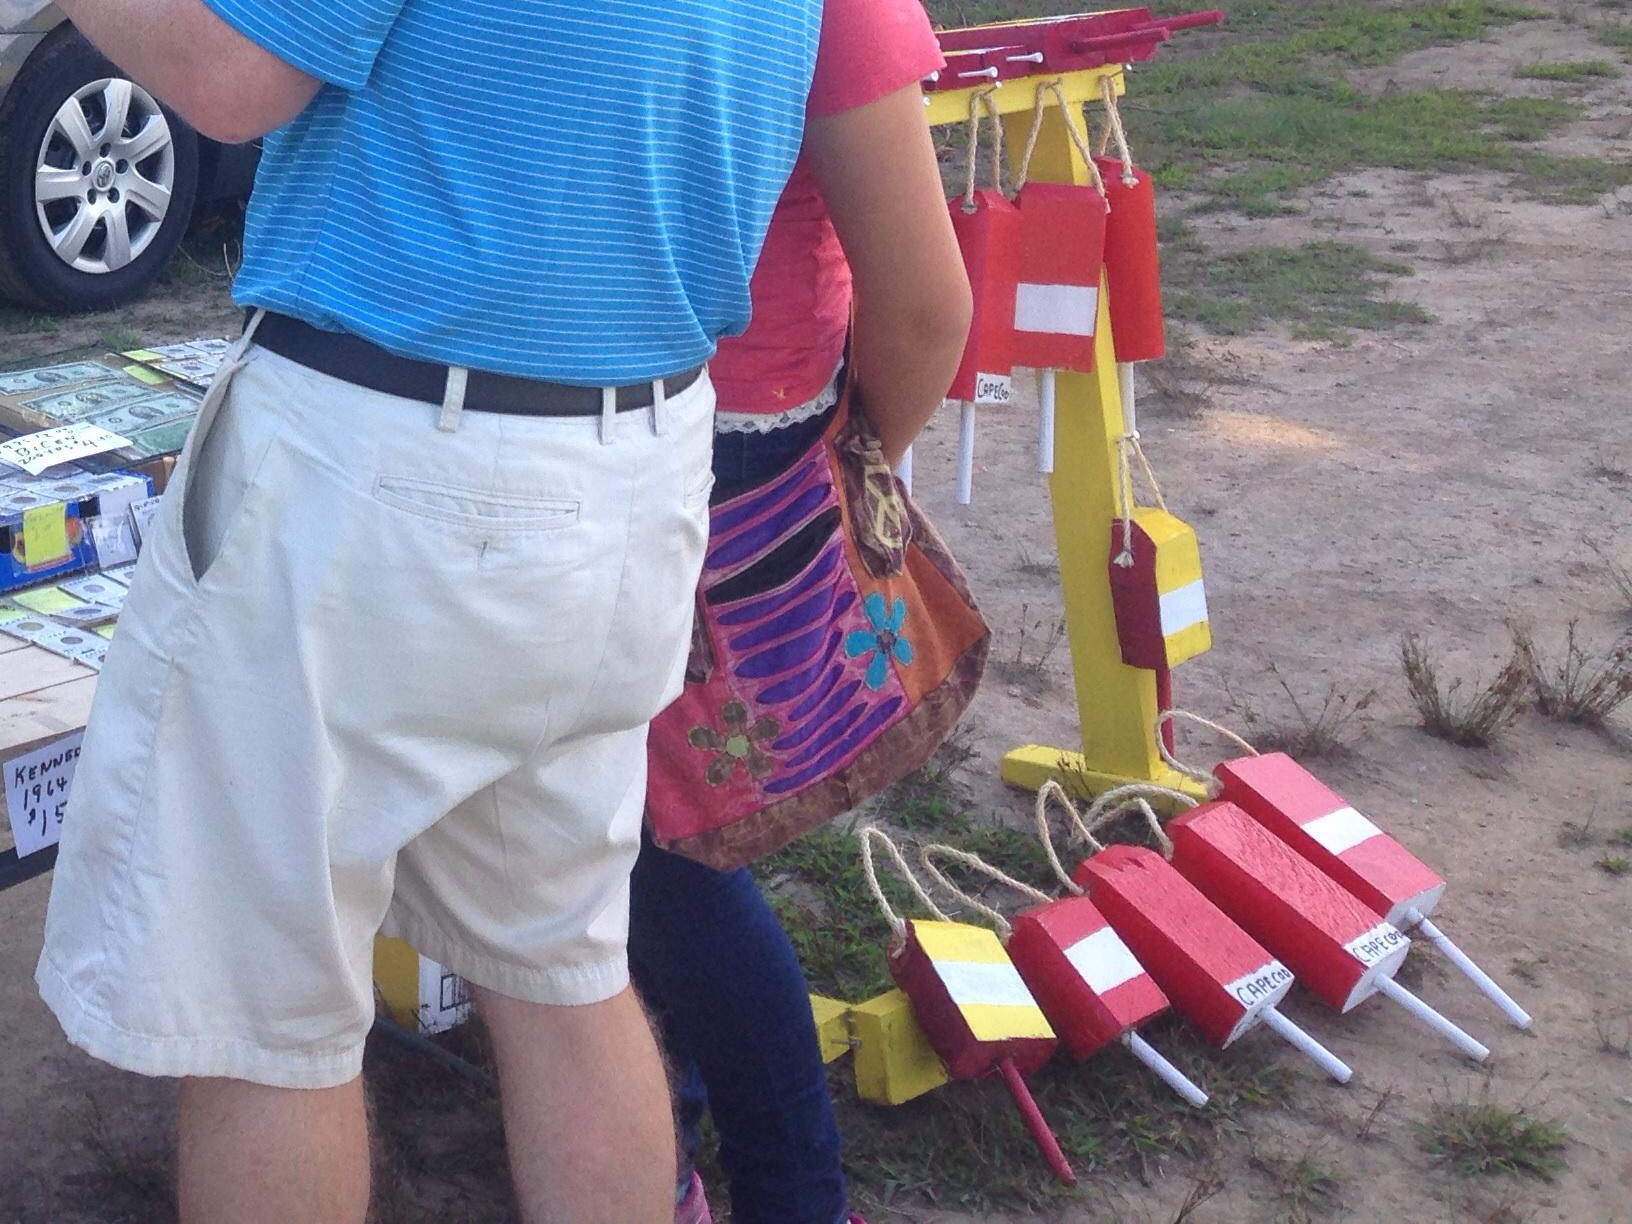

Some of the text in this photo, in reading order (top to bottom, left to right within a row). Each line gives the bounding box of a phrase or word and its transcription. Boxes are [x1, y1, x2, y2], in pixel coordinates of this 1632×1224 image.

[14, 746, 82, 789] KENNED
[24, 776, 68, 812] 1964
[1352, 937, 1388, 962] CAPE
[1235, 977, 1276, 1006] CAPE
